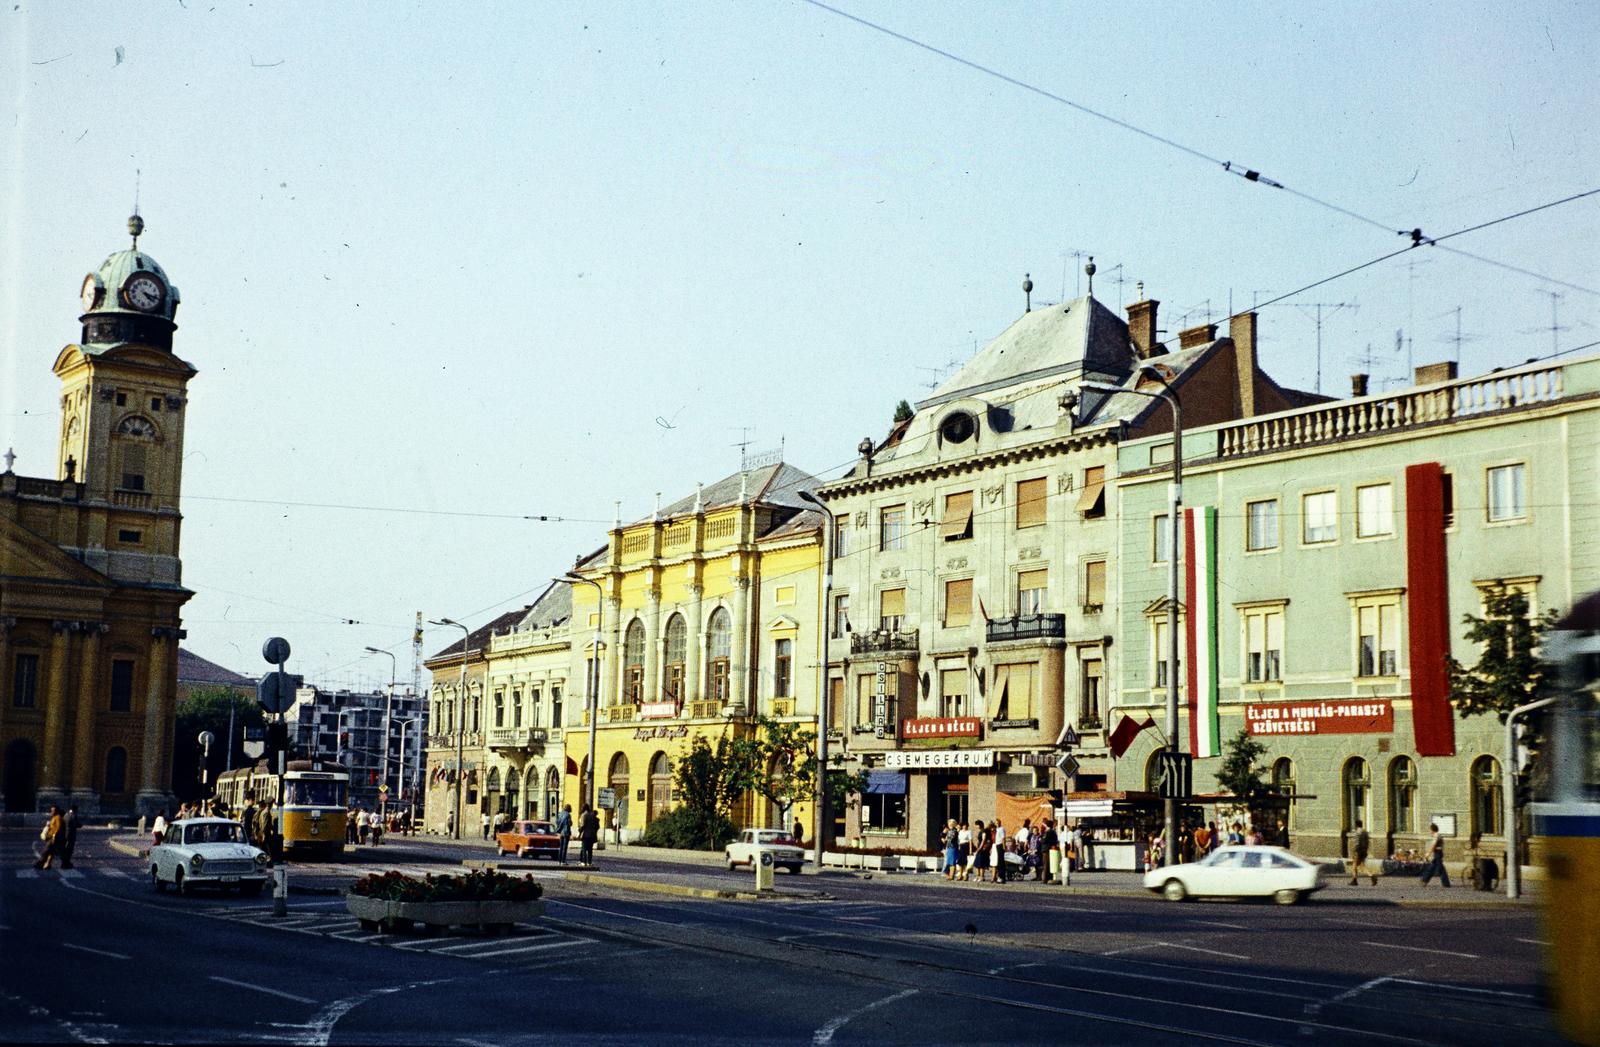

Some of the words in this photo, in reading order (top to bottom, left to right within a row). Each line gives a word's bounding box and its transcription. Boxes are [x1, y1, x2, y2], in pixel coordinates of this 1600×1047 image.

[877, 663, 885, 737] CSILLAG
[1248, 706, 1280, 719] ÉLJEN
[1283, 708, 1289, 718] A
[1291, 703, 1385, 718] MUNKÁS-PARASZT
[939, 723, 944, 732] A
[887, 752, 992, 765] CSEMEGEÁRUK
